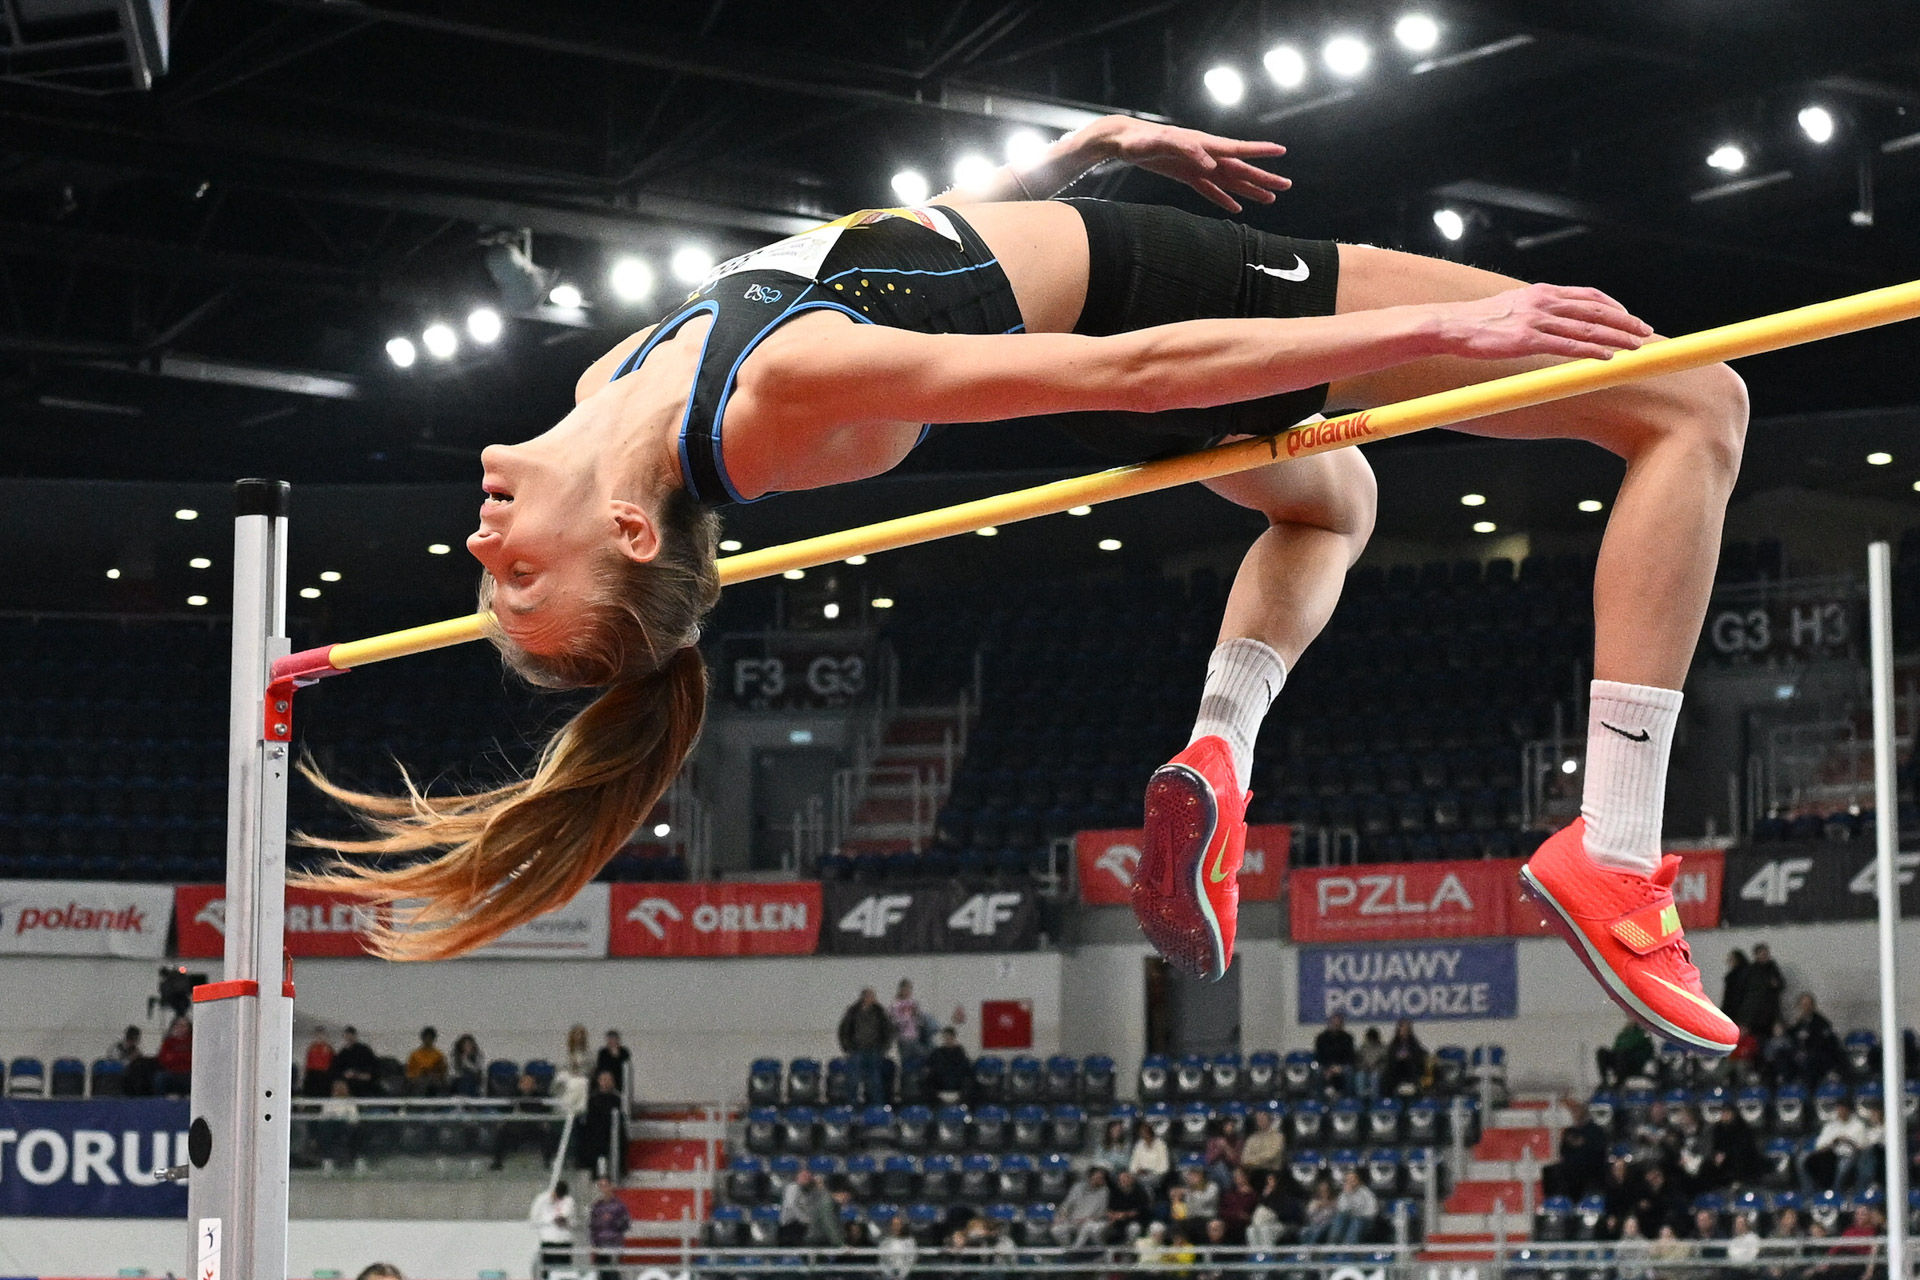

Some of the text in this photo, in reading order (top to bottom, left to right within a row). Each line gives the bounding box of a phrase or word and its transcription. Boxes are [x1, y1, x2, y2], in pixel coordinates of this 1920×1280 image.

[743, 283, 783, 304] esa
[1286, 411, 1373, 457] polanik
[1711, 603, 1847, 652] G3 H3
[734, 656, 866, 696] F3 G3
[1315, 873, 1474, 916] PZLA
[1740, 857, 1813, 905] 4F
[16, 903, 146, 935] polanik
[285, 905, 378, 933] RLEN
[692, 903, 807, 933] ORLEN
[839, 895, 912, 938] 4F
[948, 892, 1021, 936] 4F
[1324, 949, 1462, 983] KUJAWY
[1324, 982, 1491, 1018] POMORZE
